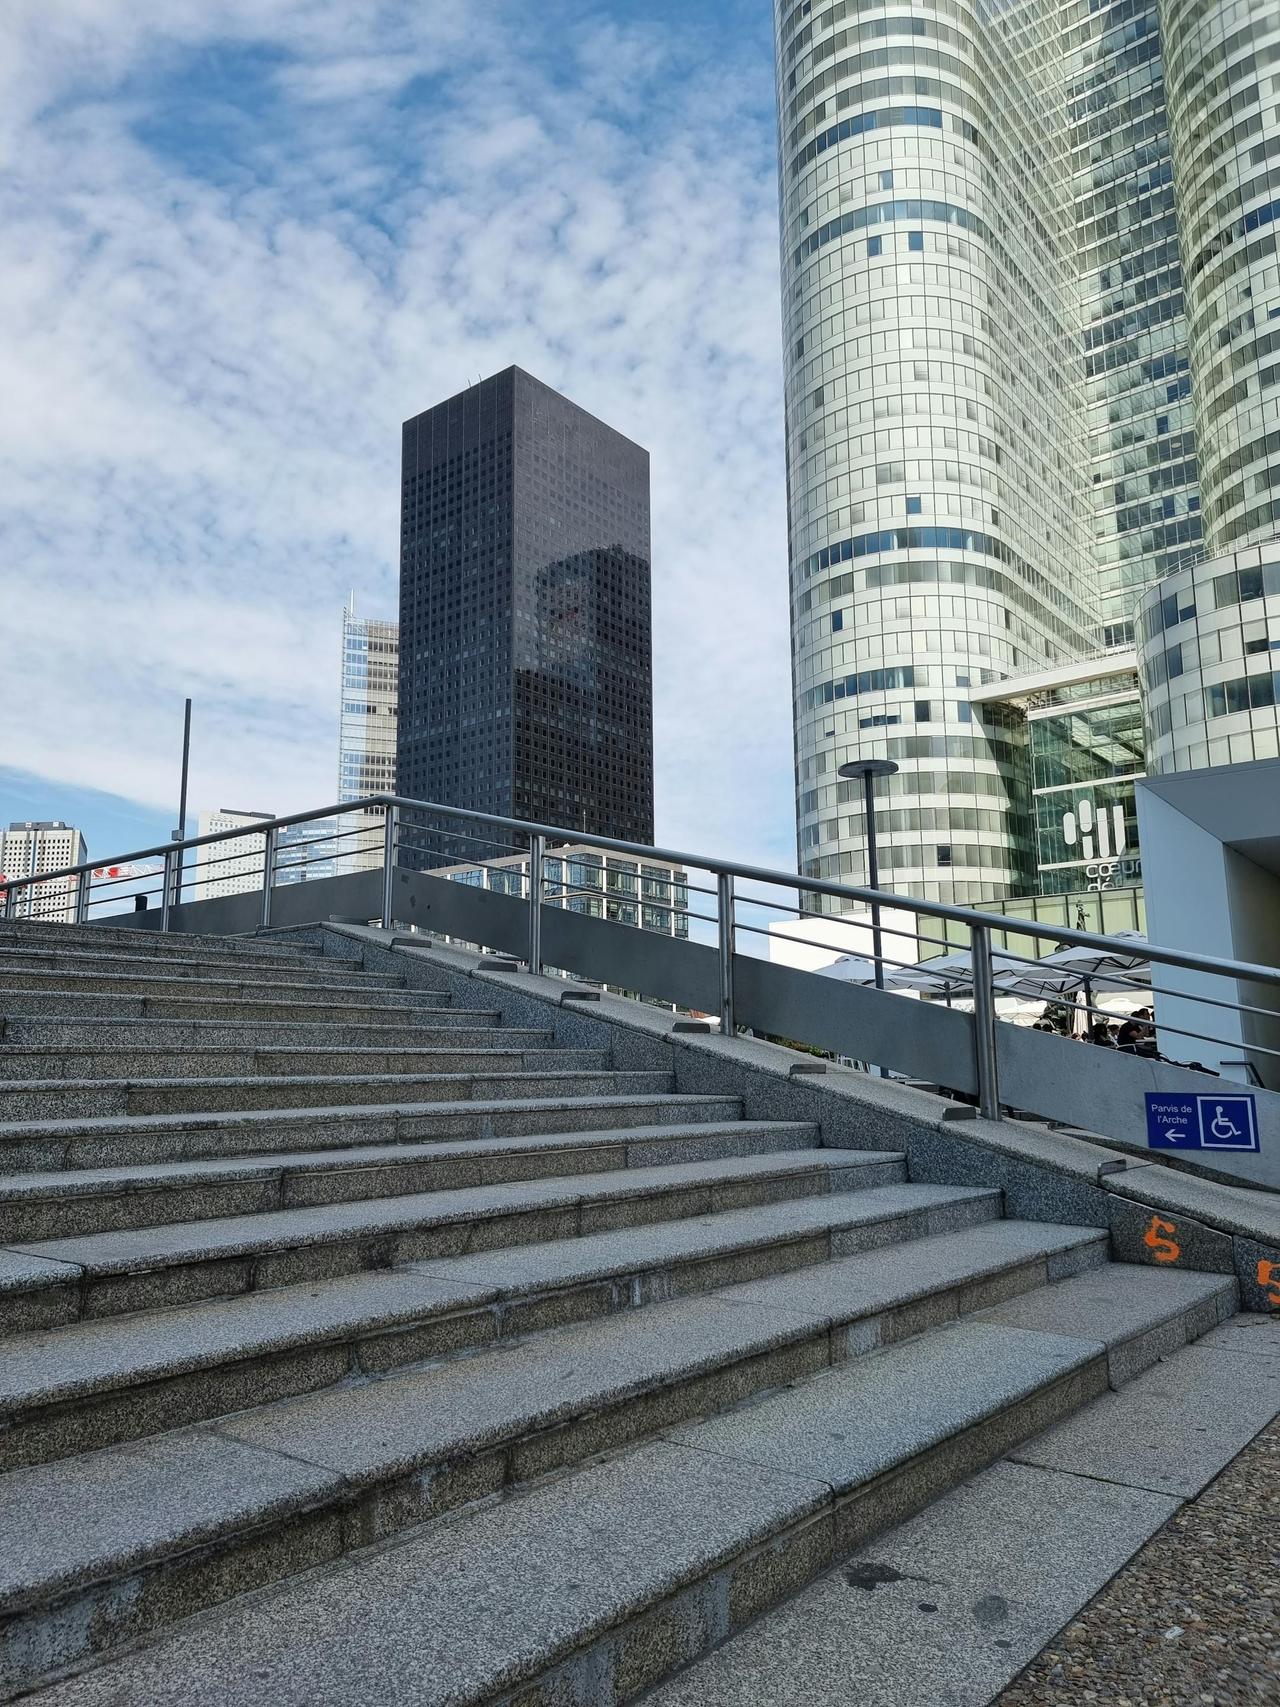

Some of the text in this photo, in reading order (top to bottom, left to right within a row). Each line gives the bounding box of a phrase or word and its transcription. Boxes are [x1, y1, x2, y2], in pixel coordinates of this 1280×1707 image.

[1151, 1104, 1192, 1113] Parvis de
[1157, 1115, 1188, 1124] l'Arche
